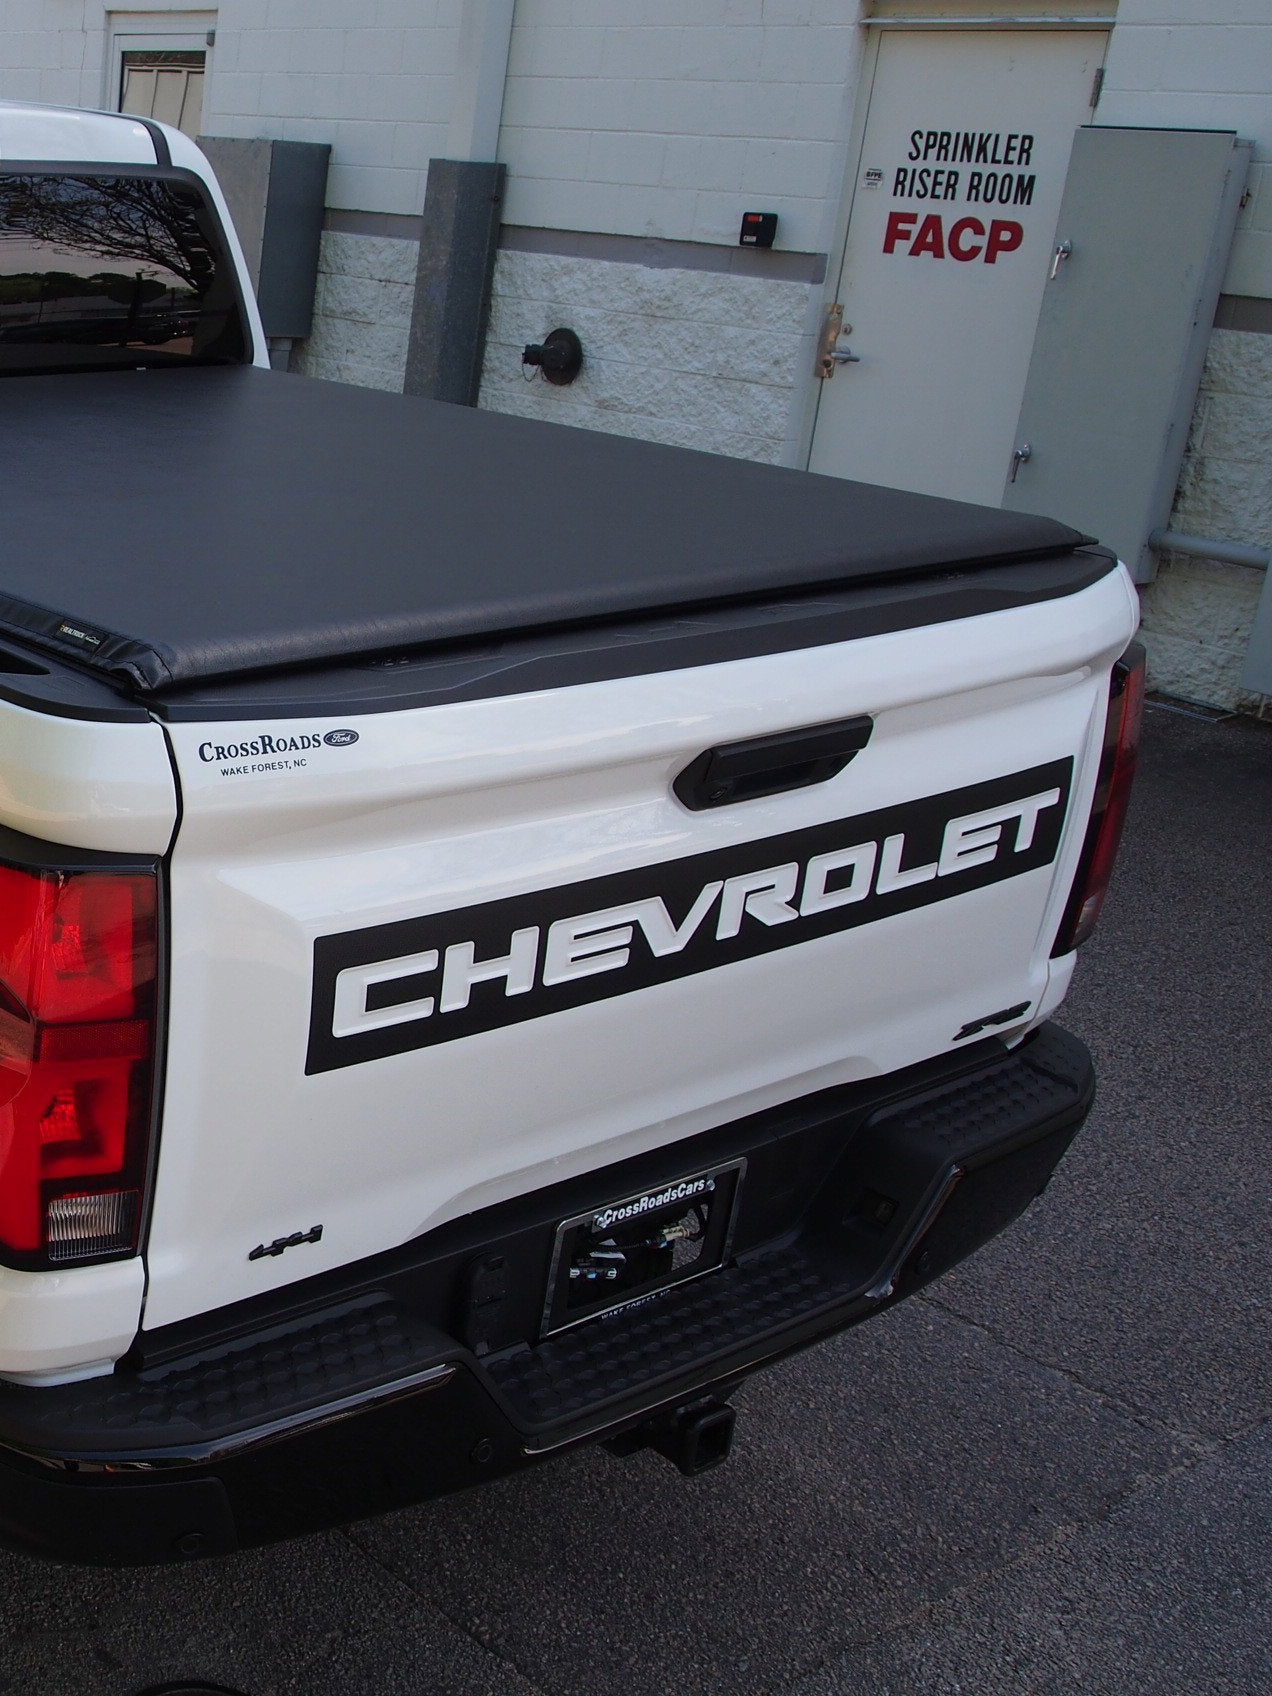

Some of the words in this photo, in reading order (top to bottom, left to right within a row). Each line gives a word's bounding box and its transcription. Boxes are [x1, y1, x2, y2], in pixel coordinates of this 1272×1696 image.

[908, 130, 1035, 166] SPRINKLER
[892, 167, 959, 201] RISER
[966, 171, 1036, 206] ROOM
[882, 211, 1024, 264] FACP
[221, 766, 249, 777] WAKE
[252, 761, 292, 773] FOREST,
[293, 758, 307, 768] NC
[333, 788, 1061, 1038] CHEVROLET
[602, 1178, 705, 1226] CrossRoadsCars
